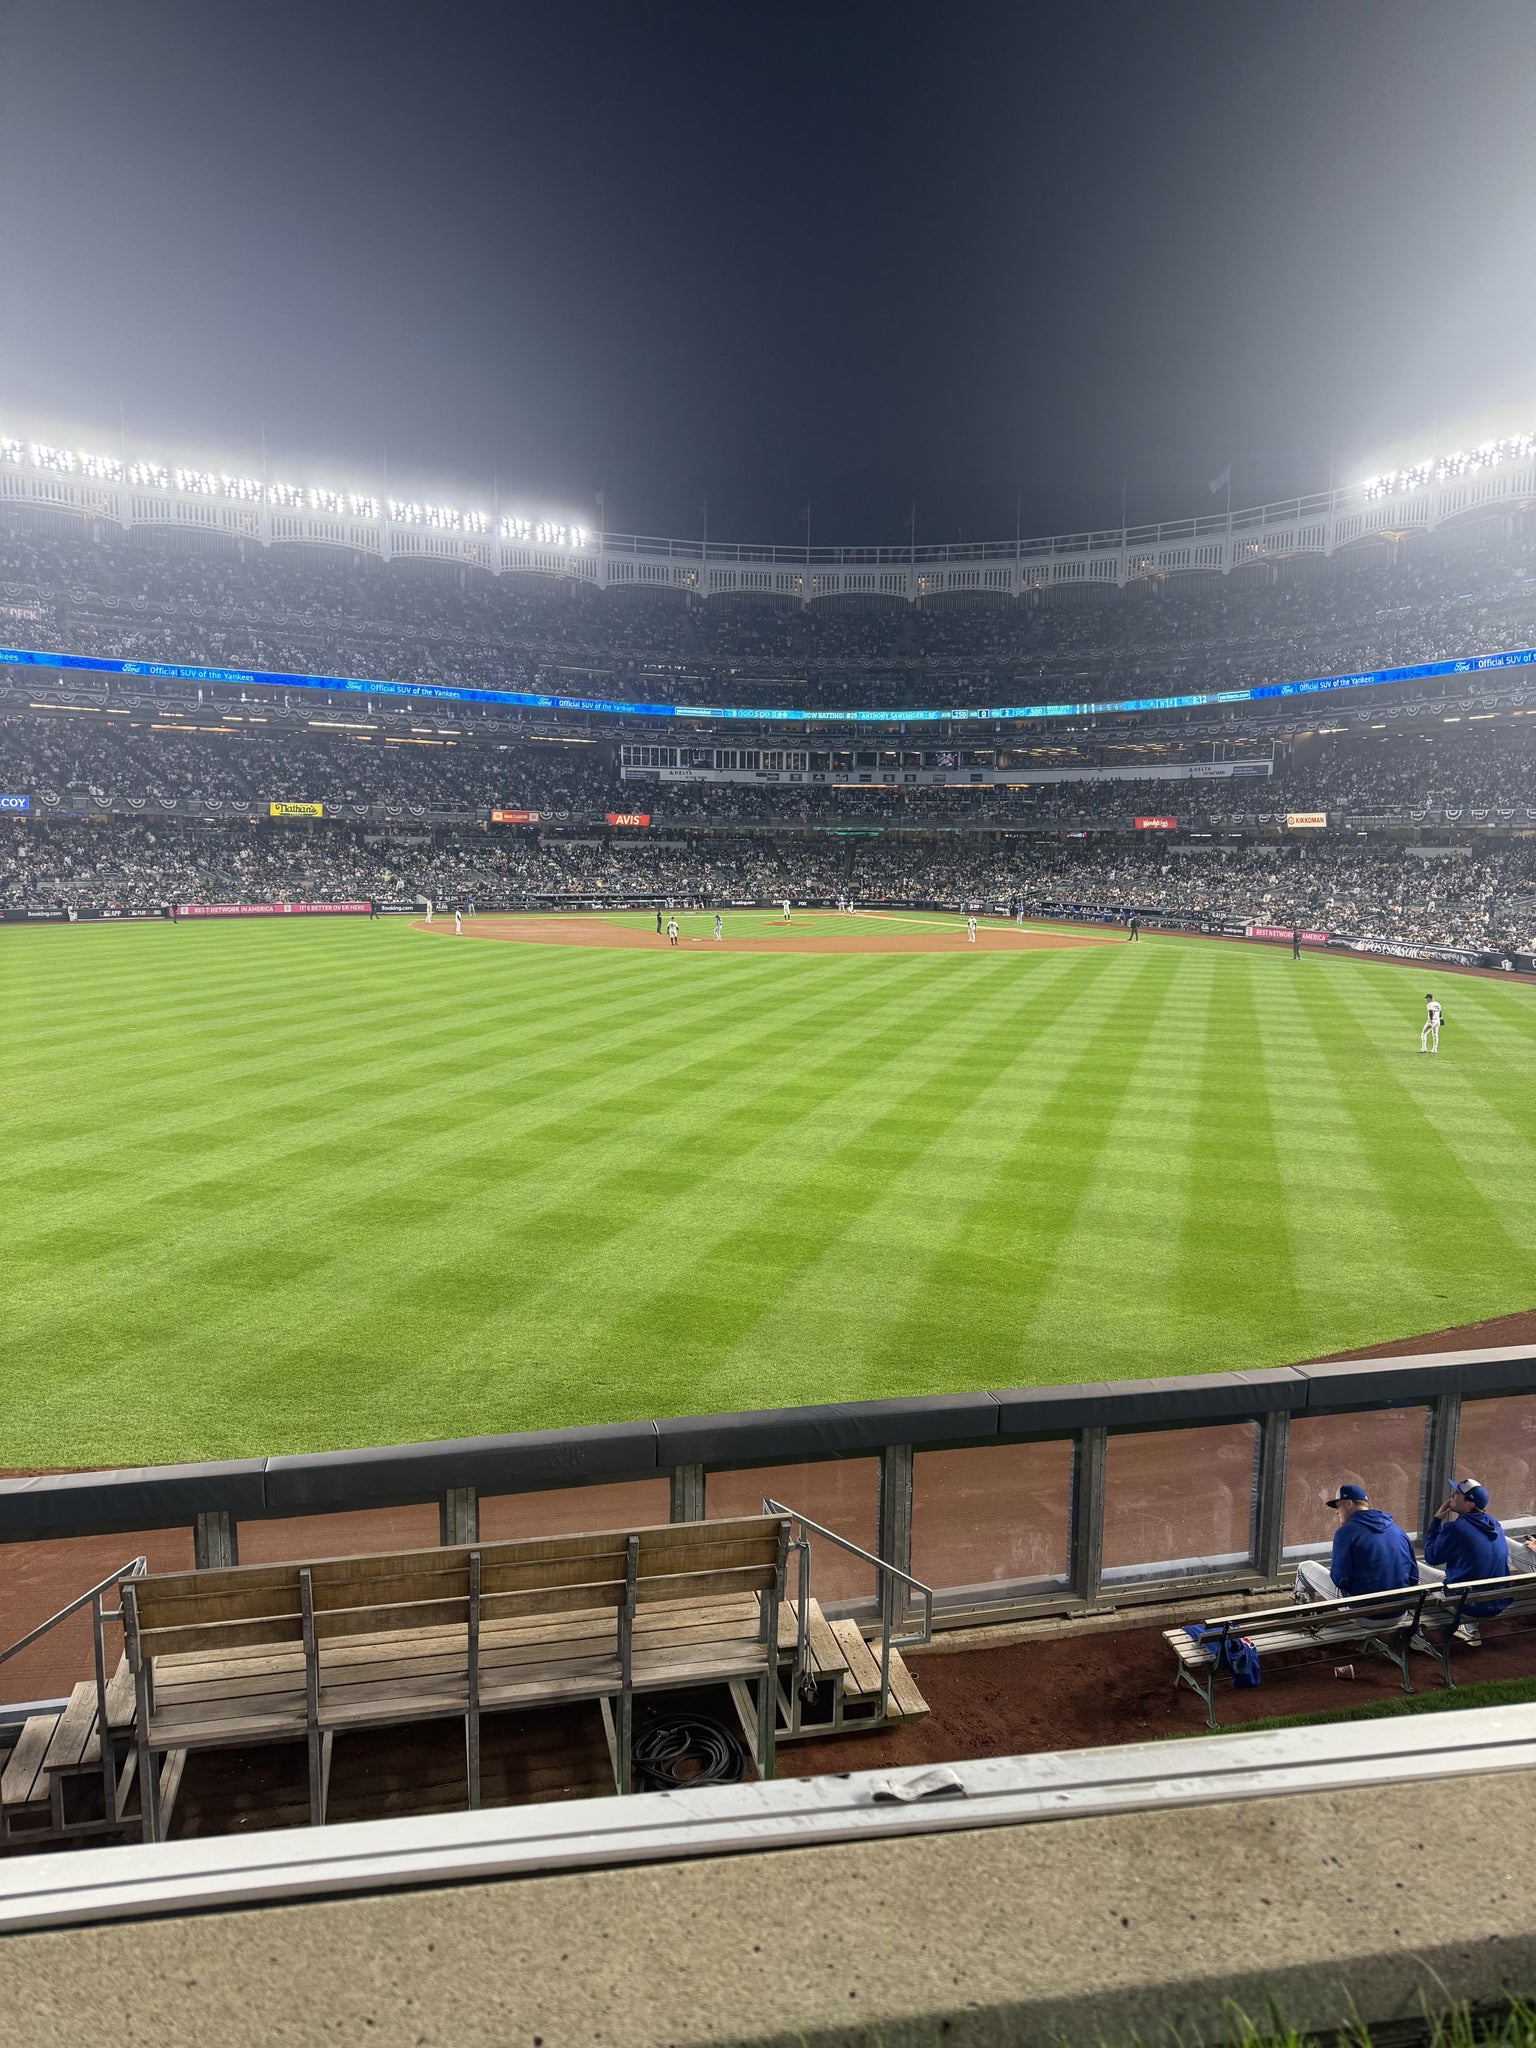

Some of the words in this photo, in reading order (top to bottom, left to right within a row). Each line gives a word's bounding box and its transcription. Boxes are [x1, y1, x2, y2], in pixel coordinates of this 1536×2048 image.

[1454, 662, 1470, 672] Ford
[1478, 657, 1504, 668] Official
[1506, 655, 1522, 664] SUV
[1523, 653, 1531, 662] of
[122, 663, 141, 672] Ford
[149, 665, 178, 676] Official
[180, 669, 197, 677] SUV
[198, 670, 206, 678] of
[208, 671, 222, 679] the
[224, 672, 254, 681] Yankees
[1299, 681, 1319, 691] Official
[1319, 681, 1331, 689] SUV
[1340, 678, 1350, 686] the
[1350, 676, 1375, 685] Yankees
[370, 684, 395, 692] Official
[412, 687, 421, 695] of
[421, 688, 433, 696] the
[434, 690, 460, 698] Yankees
[559, 700, 580, 708] Official
[595, 702, 601, 710] of
[602, 702, 612, 710] the
[613, 704, 635, 712] Yankees
[275, 803, 317, 814] Nathan's
[615, 815, 640, 825] AVIS
[1255, 928, 1269, 936] BEST
[1301, 932, 1326, 941] AMERICA
[1365, 940, 1420, 959] POSTSEASON
